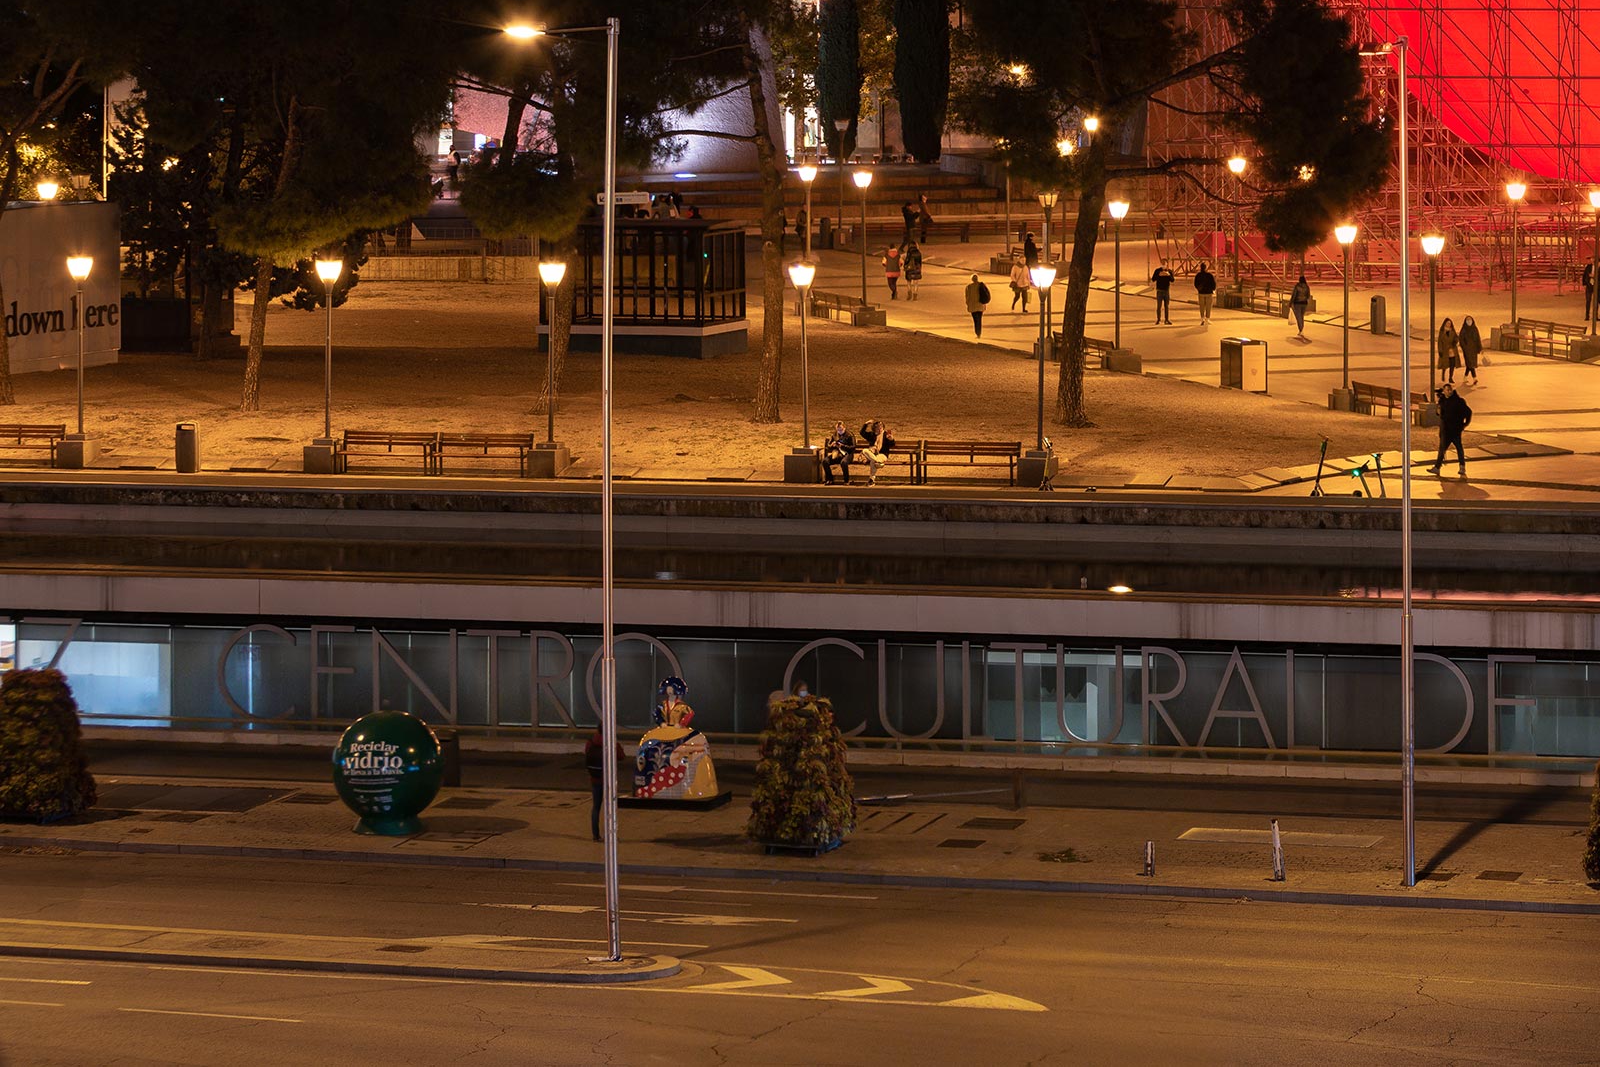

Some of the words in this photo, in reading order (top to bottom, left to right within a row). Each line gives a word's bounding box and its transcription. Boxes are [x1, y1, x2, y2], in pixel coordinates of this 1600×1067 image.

[5, 300, 66, 338] down
[218, 624, 684, 730] CENTRO
[783, 637, 1321, 750] CULTURAL
[345, 751, 403, 769] vidrio
[350, 741, 399, 753] Reciclar
